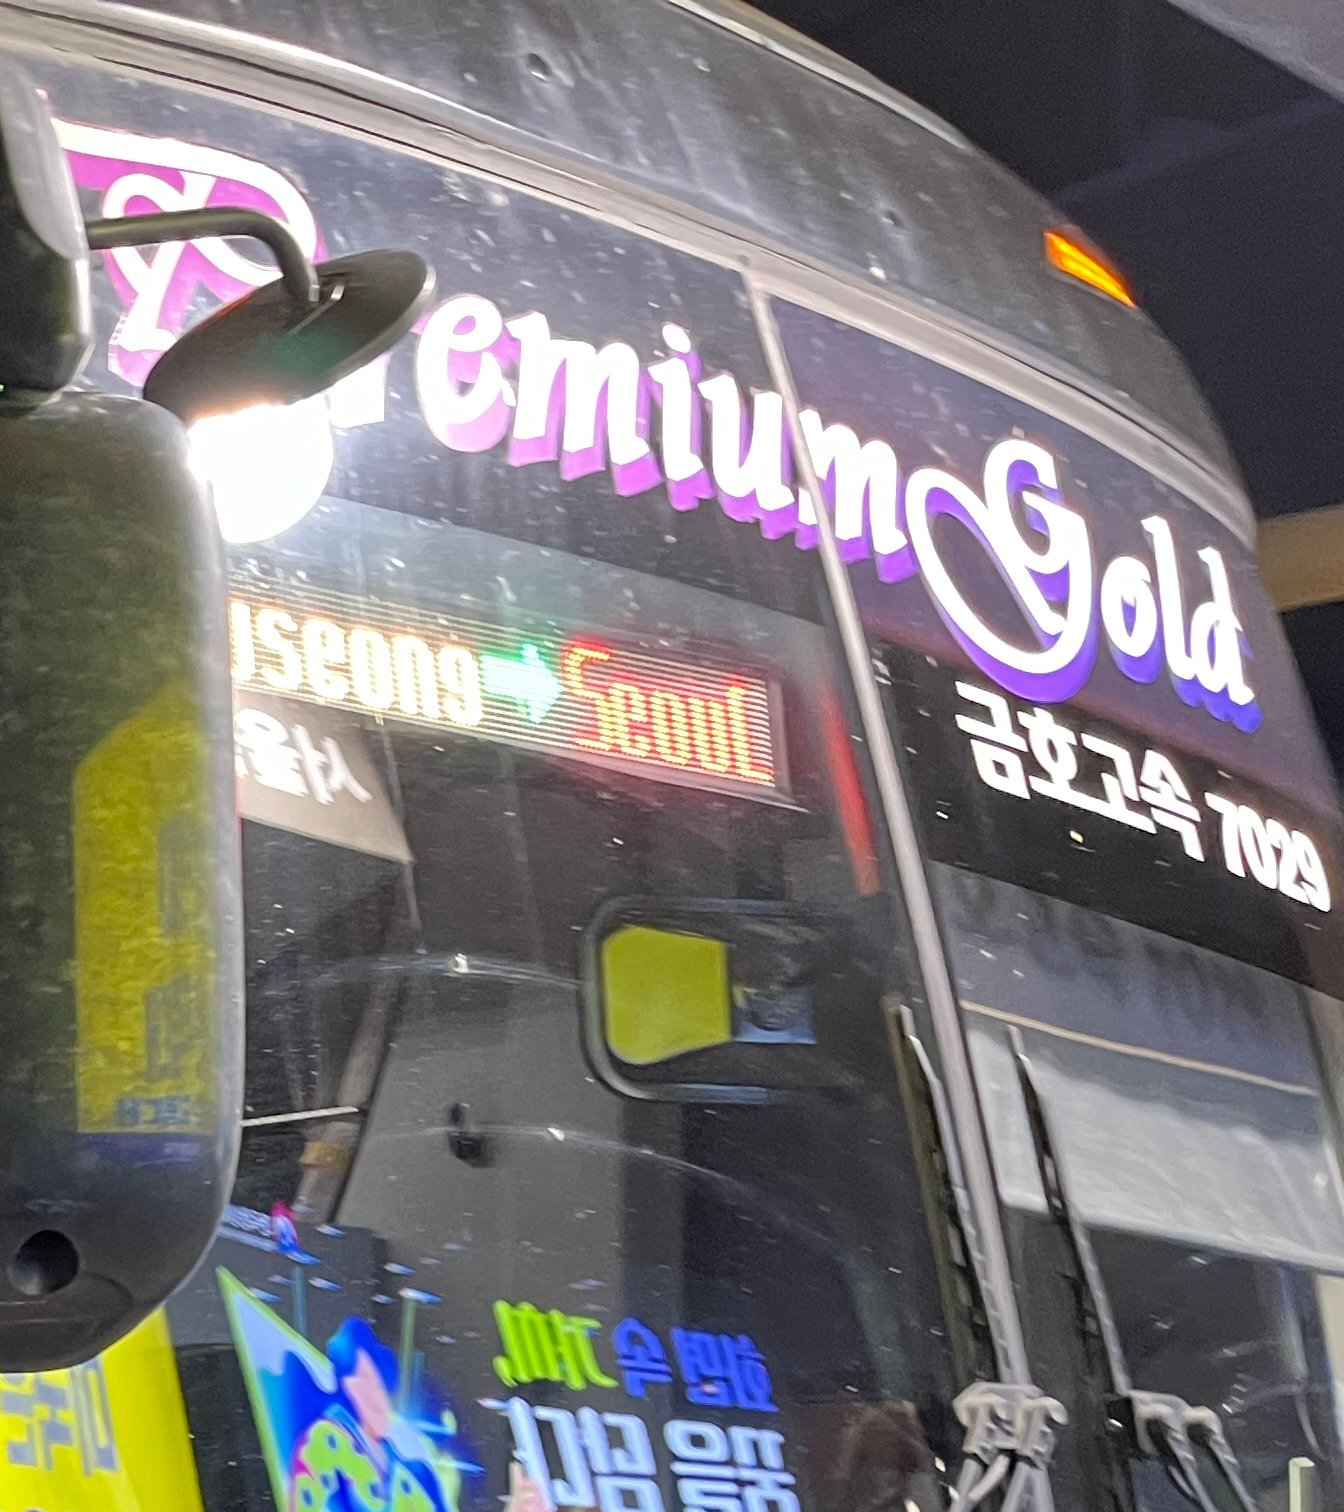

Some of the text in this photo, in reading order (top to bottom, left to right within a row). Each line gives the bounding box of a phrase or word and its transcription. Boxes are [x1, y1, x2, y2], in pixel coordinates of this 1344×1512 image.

[52, 115, 1256, 708] Pemium Gold
[562, 640, 775, 786] Seoul
[954, 679, 1332, 913] 금호고속 7029
